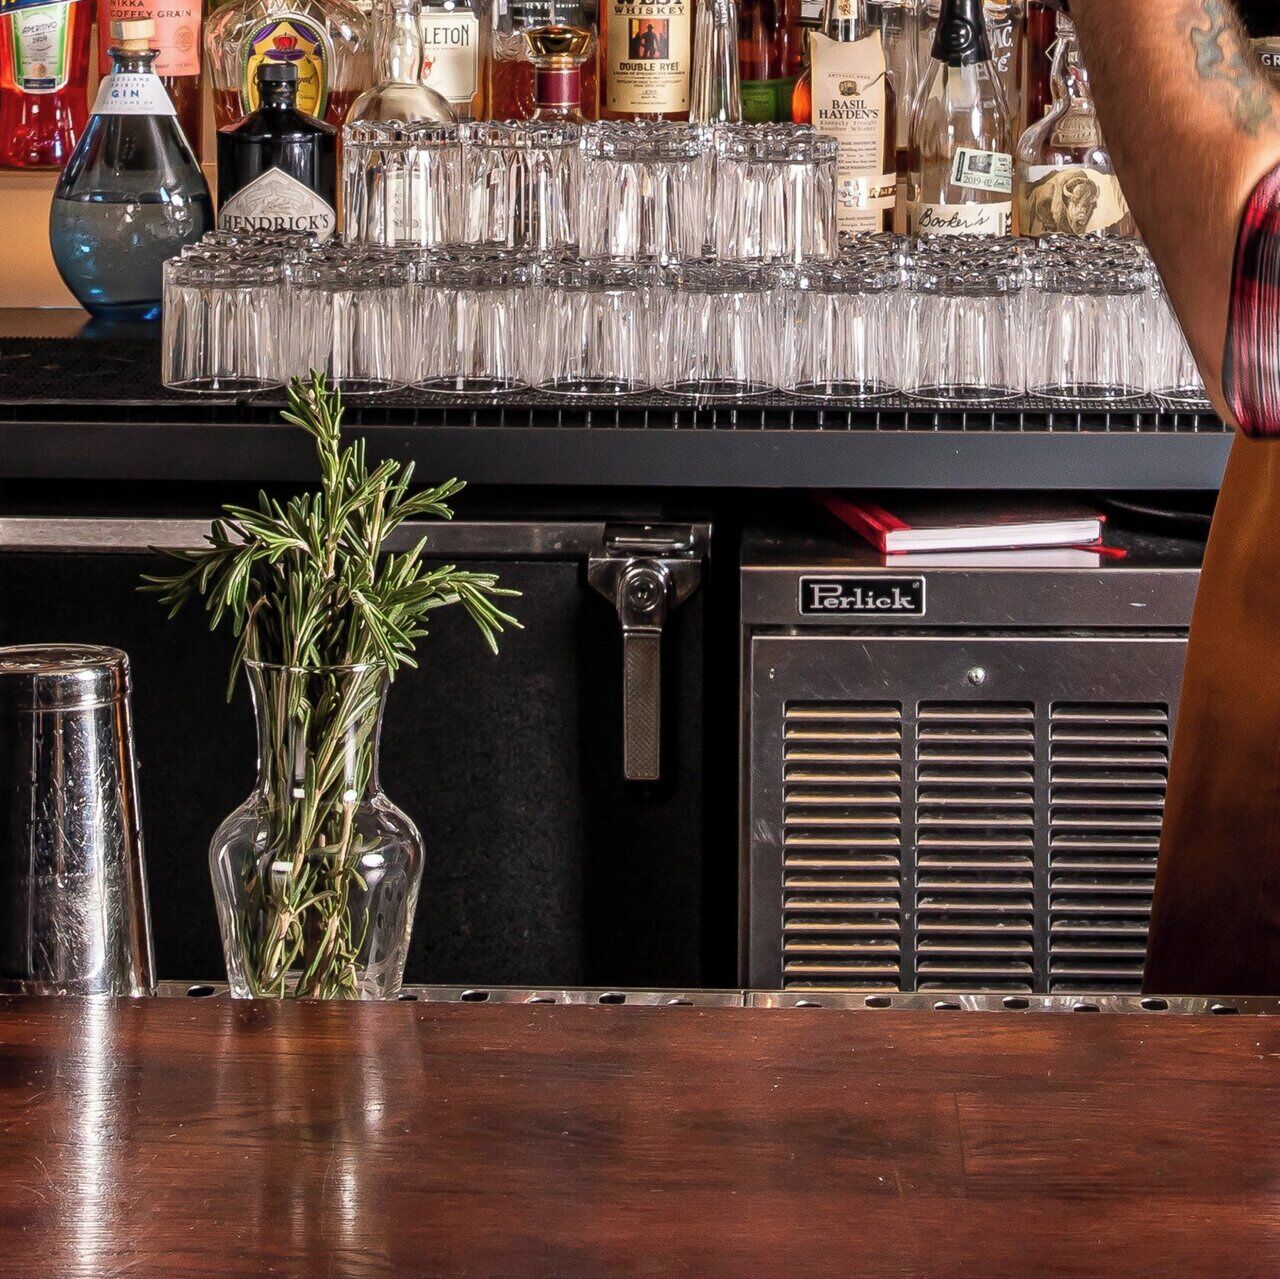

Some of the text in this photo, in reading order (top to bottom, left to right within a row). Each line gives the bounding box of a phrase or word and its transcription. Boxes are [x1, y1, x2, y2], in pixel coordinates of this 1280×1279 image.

[109, 0, 145, 8] NIKKA
[109, 8, 193, 18] COFFEY GRAIN
[614, 6, 685, 16] WHISKEY
[423, 25, 470, 48] LETON
[619, 62, 656, 72] DOUBLE
[111, 90, 140, 98] GIN
[831, 99, 867, 110] BASIL
[818, 109, 880, 120] HAYDEN'S
[963, 175, 993, 188] 2019-02
[223, 213, 330, 232] HENDRICK'S
[919, 207, 990, 230] Booker's
[809, 583, 916, 611] Perlick
